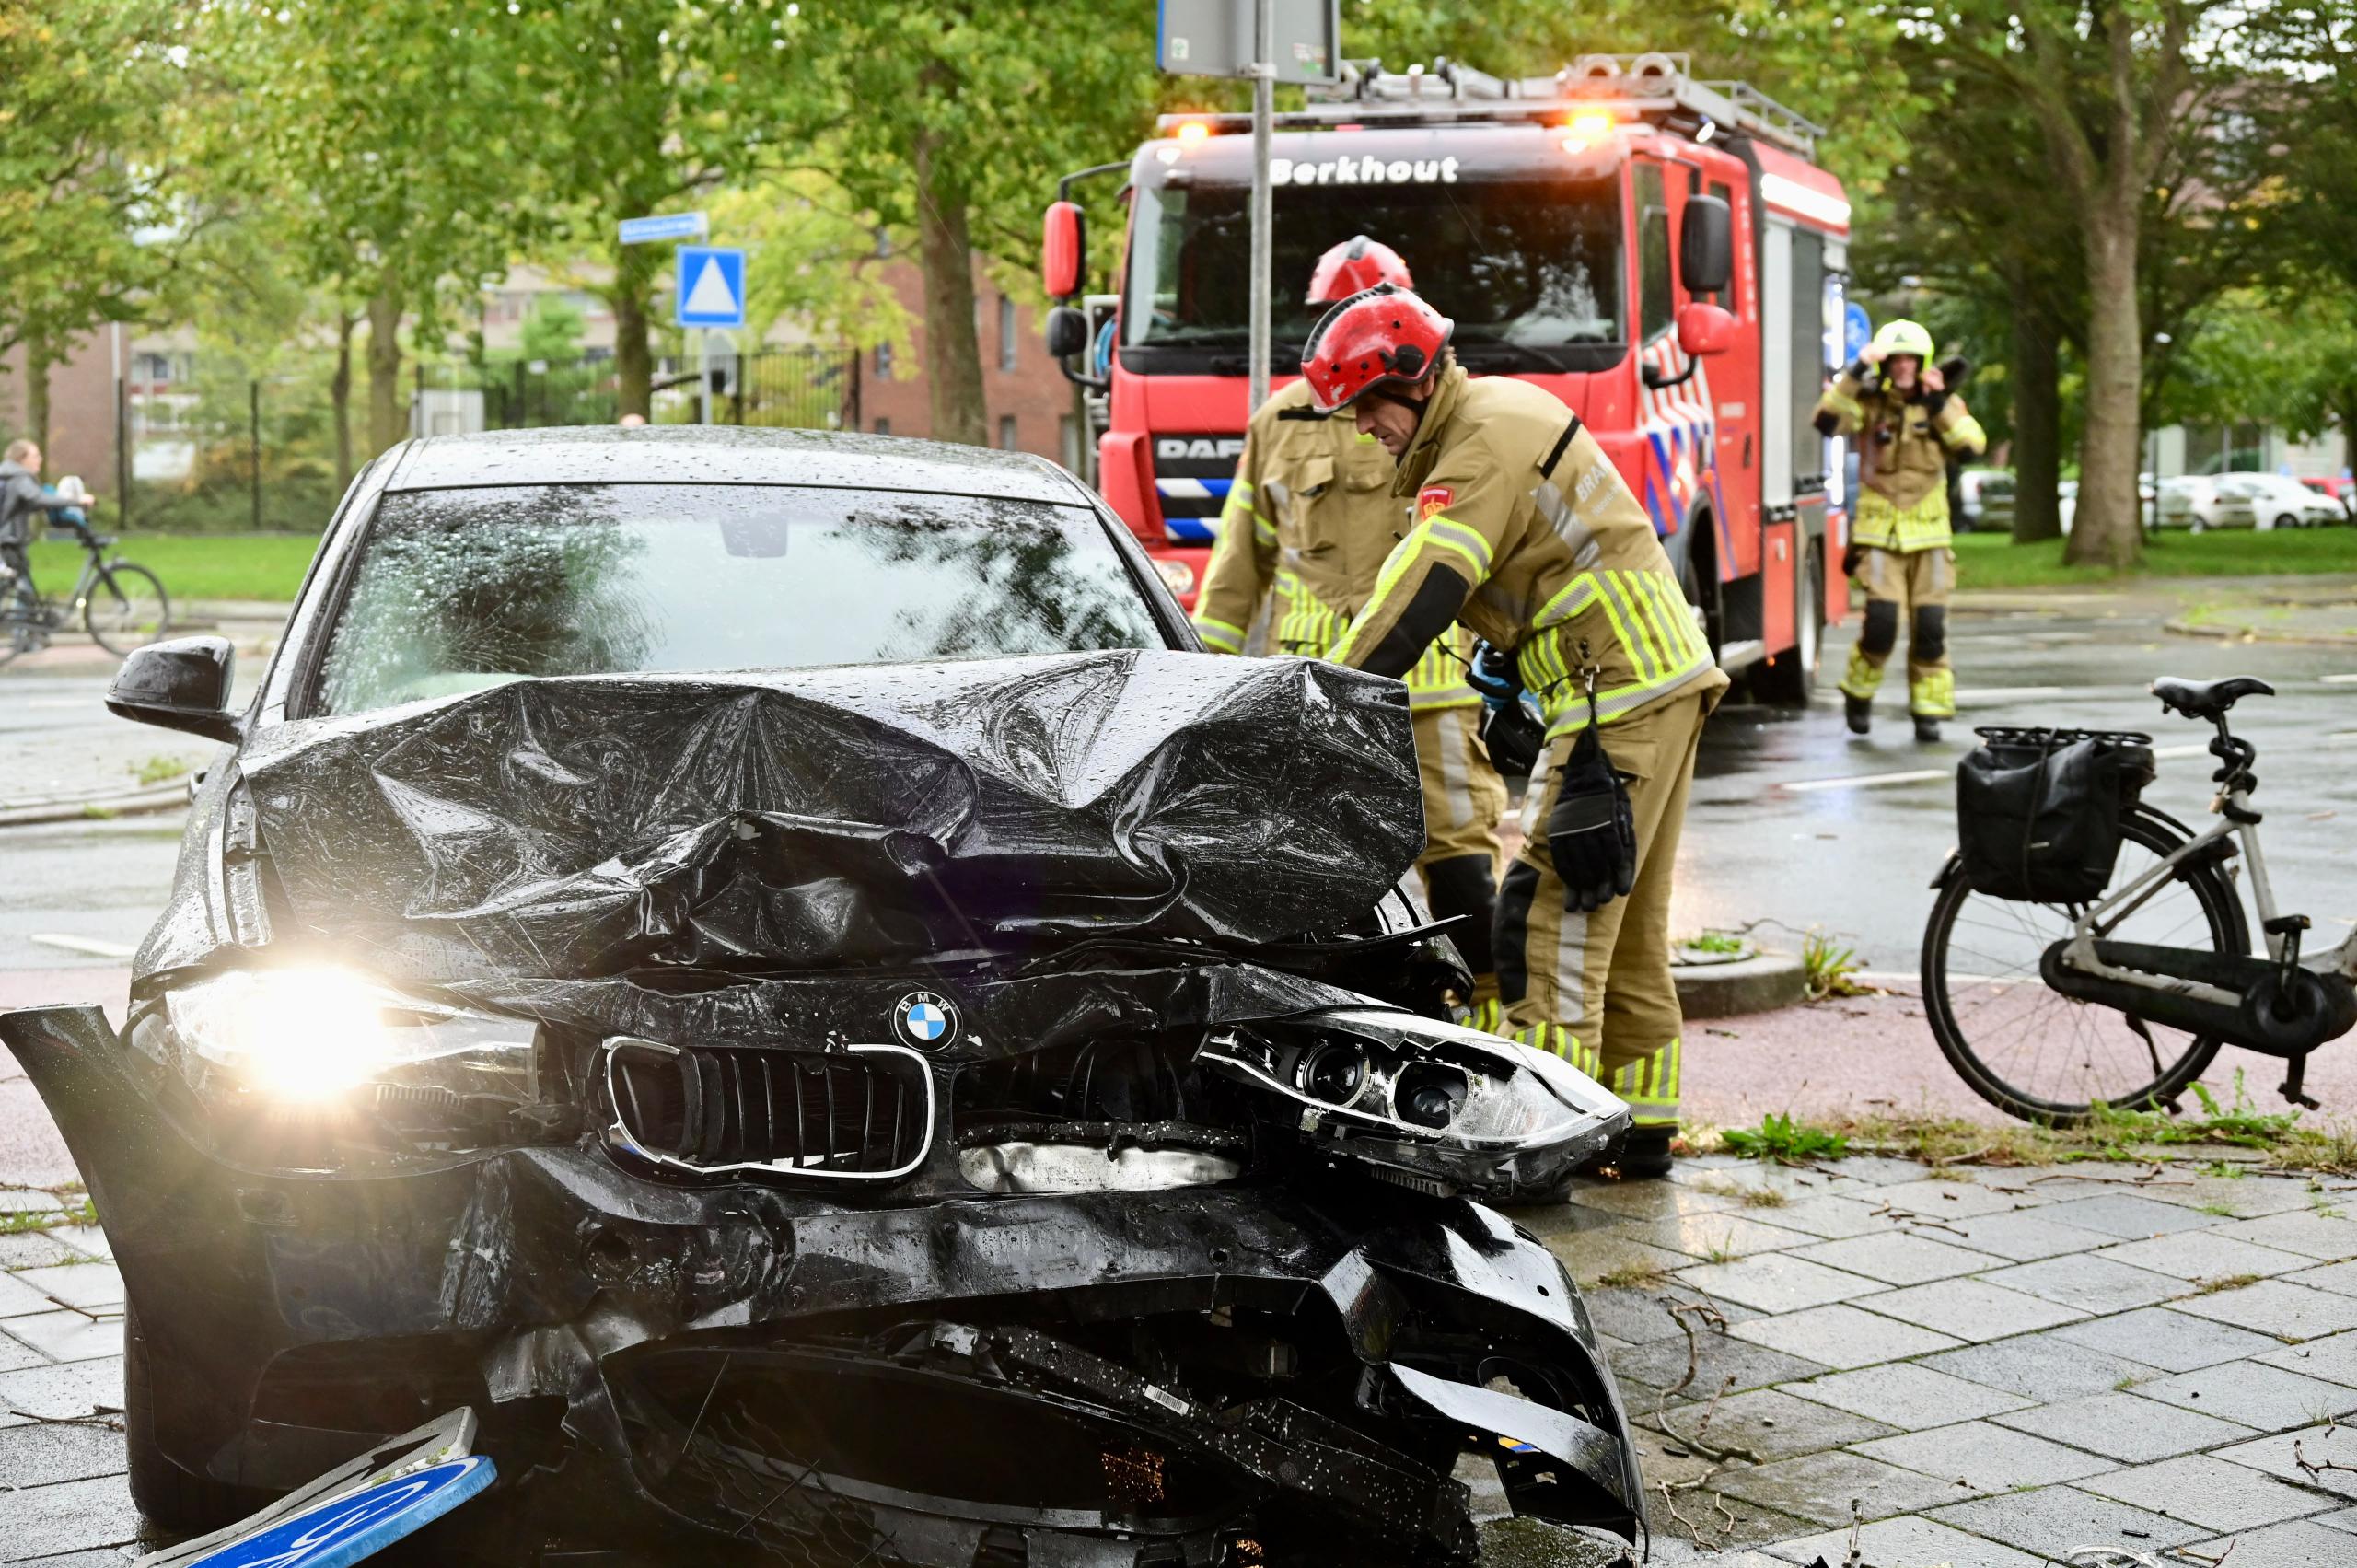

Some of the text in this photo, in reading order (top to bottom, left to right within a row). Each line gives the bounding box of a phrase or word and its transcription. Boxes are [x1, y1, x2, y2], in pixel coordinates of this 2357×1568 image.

[1269, 155, 1459, 184] Berkhout
[1157, 439, 1245, 459] DAF
[899, 993, 950, 1013] BMW
